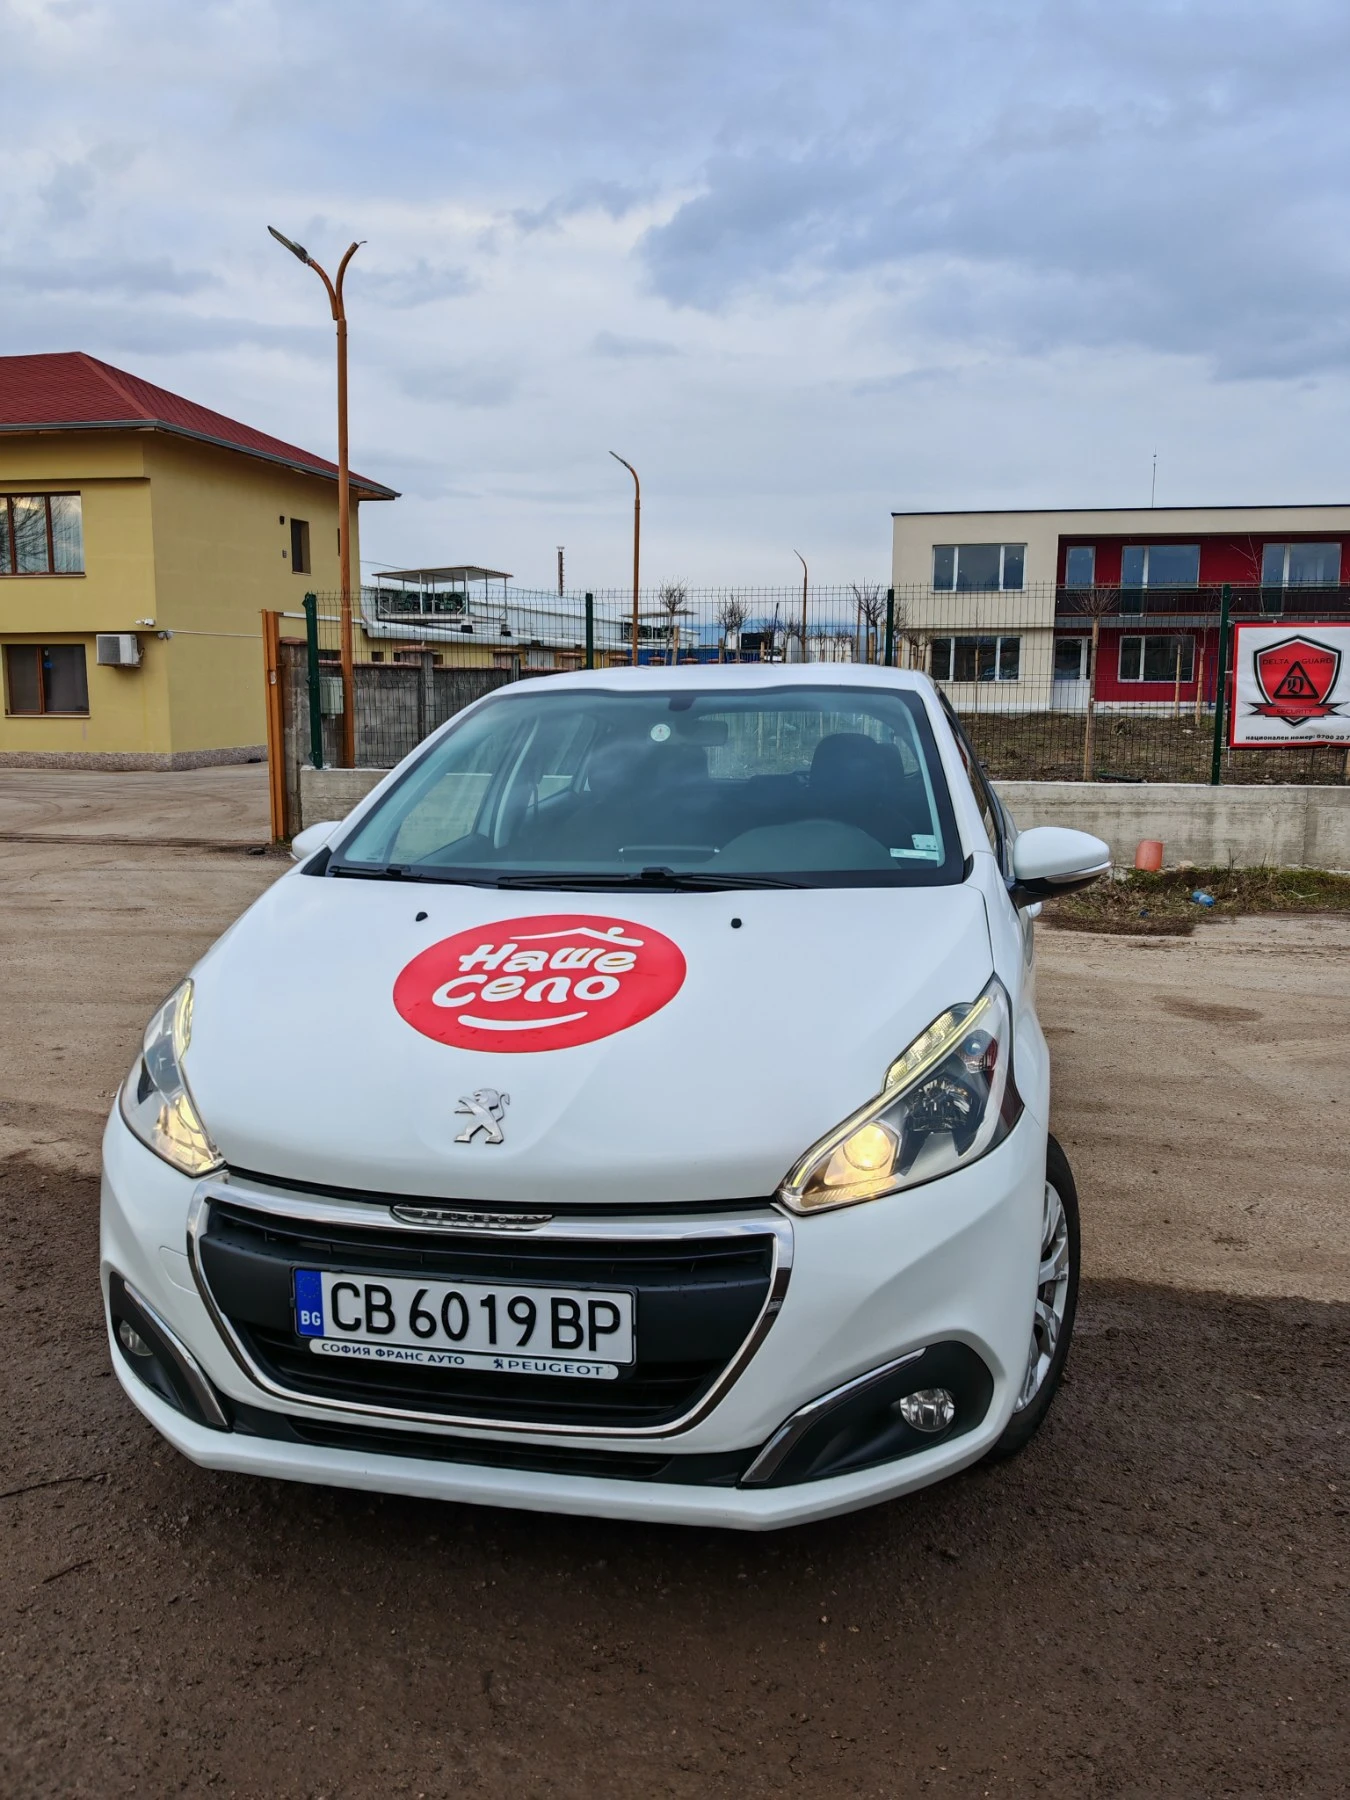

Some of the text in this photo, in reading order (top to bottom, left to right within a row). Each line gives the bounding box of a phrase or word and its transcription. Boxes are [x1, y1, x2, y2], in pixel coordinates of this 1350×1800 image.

[1302, 657, 1333, 665] GUARD
[458, 943, 637, 974] Наше
[421, 1210, 523, 1223] PEUGEO
[300, 1310, 321, 1326] BG
[321, 1343, 465, 1366] СОФИЯ ФРАНС АУТО
[508, 1361, 604, 1376] PEUGEOT
